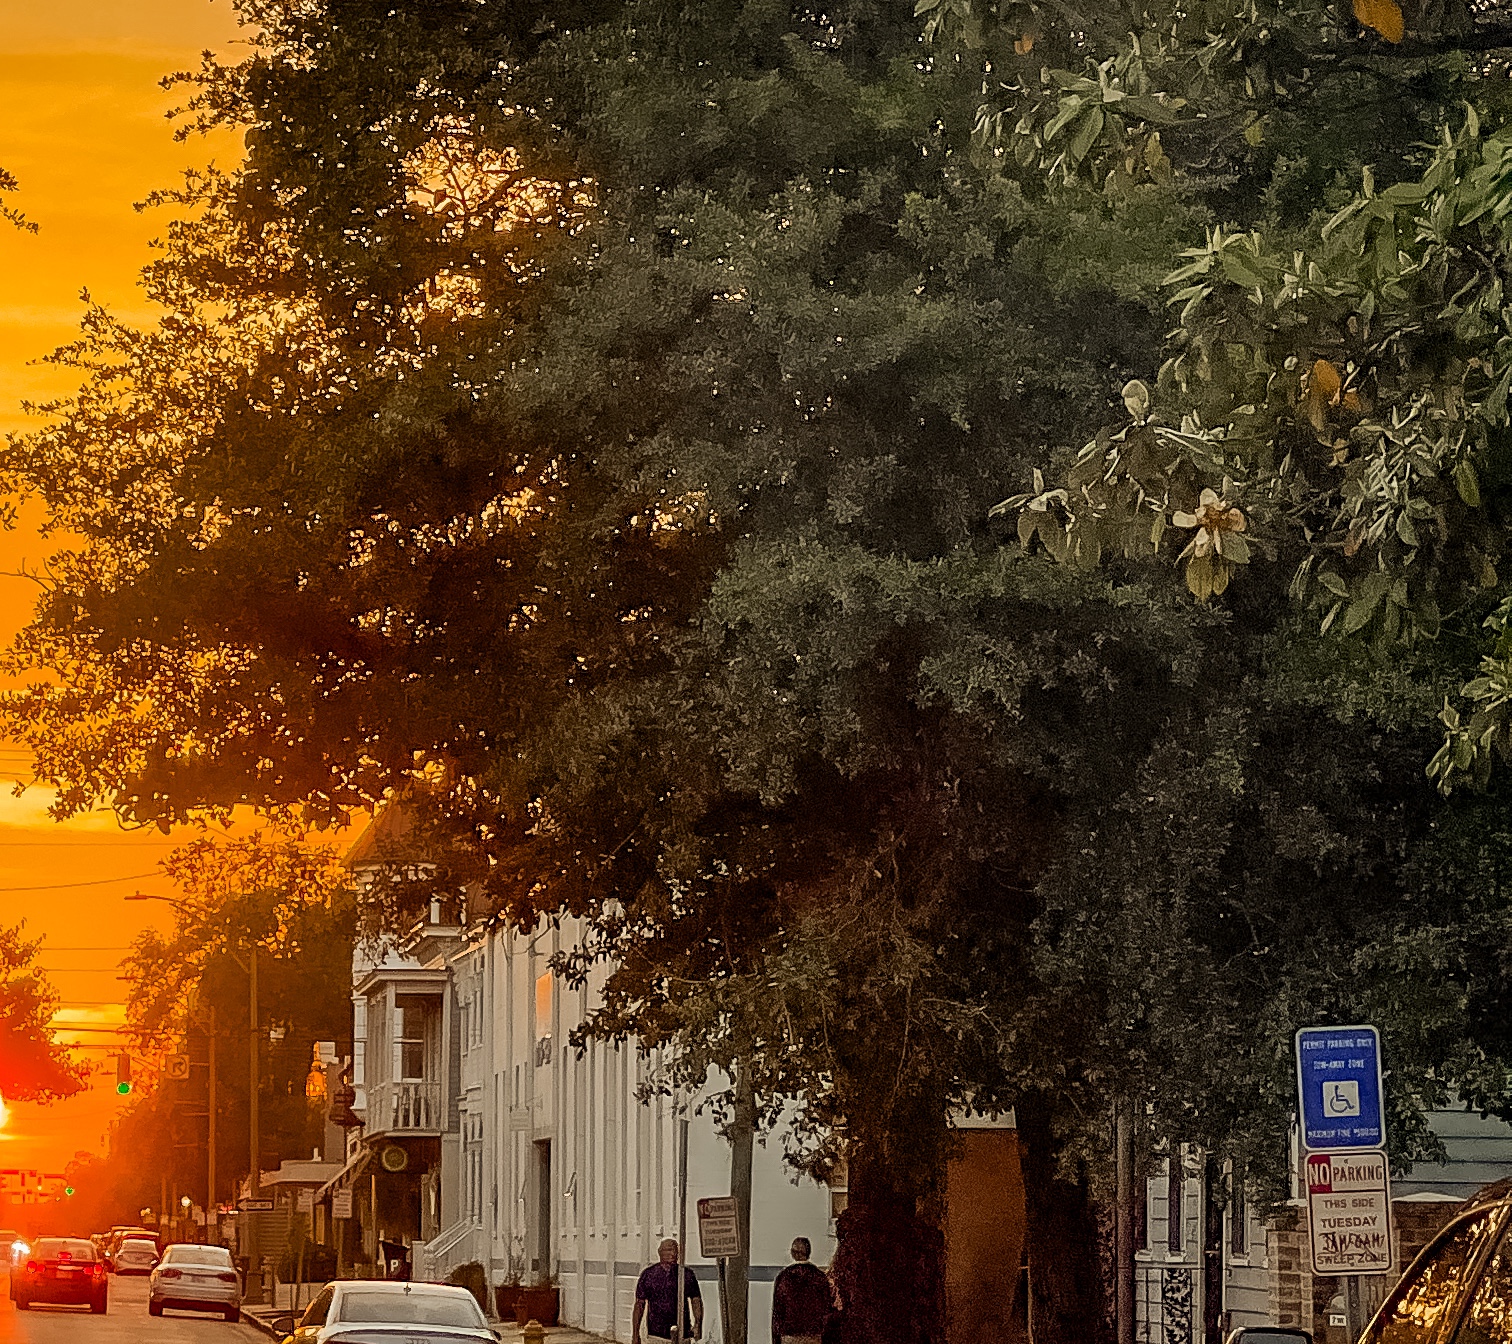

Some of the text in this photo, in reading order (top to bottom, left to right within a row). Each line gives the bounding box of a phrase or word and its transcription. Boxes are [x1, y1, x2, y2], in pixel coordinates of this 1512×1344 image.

[1308, 1162, 1383, 1187] NO PARKING
[1323, 1197, 1375, 1209] THIS SIDE
[1320, 1216, 1378, 1229] TUESDAY
[390, 1259, 399, 1272] P
